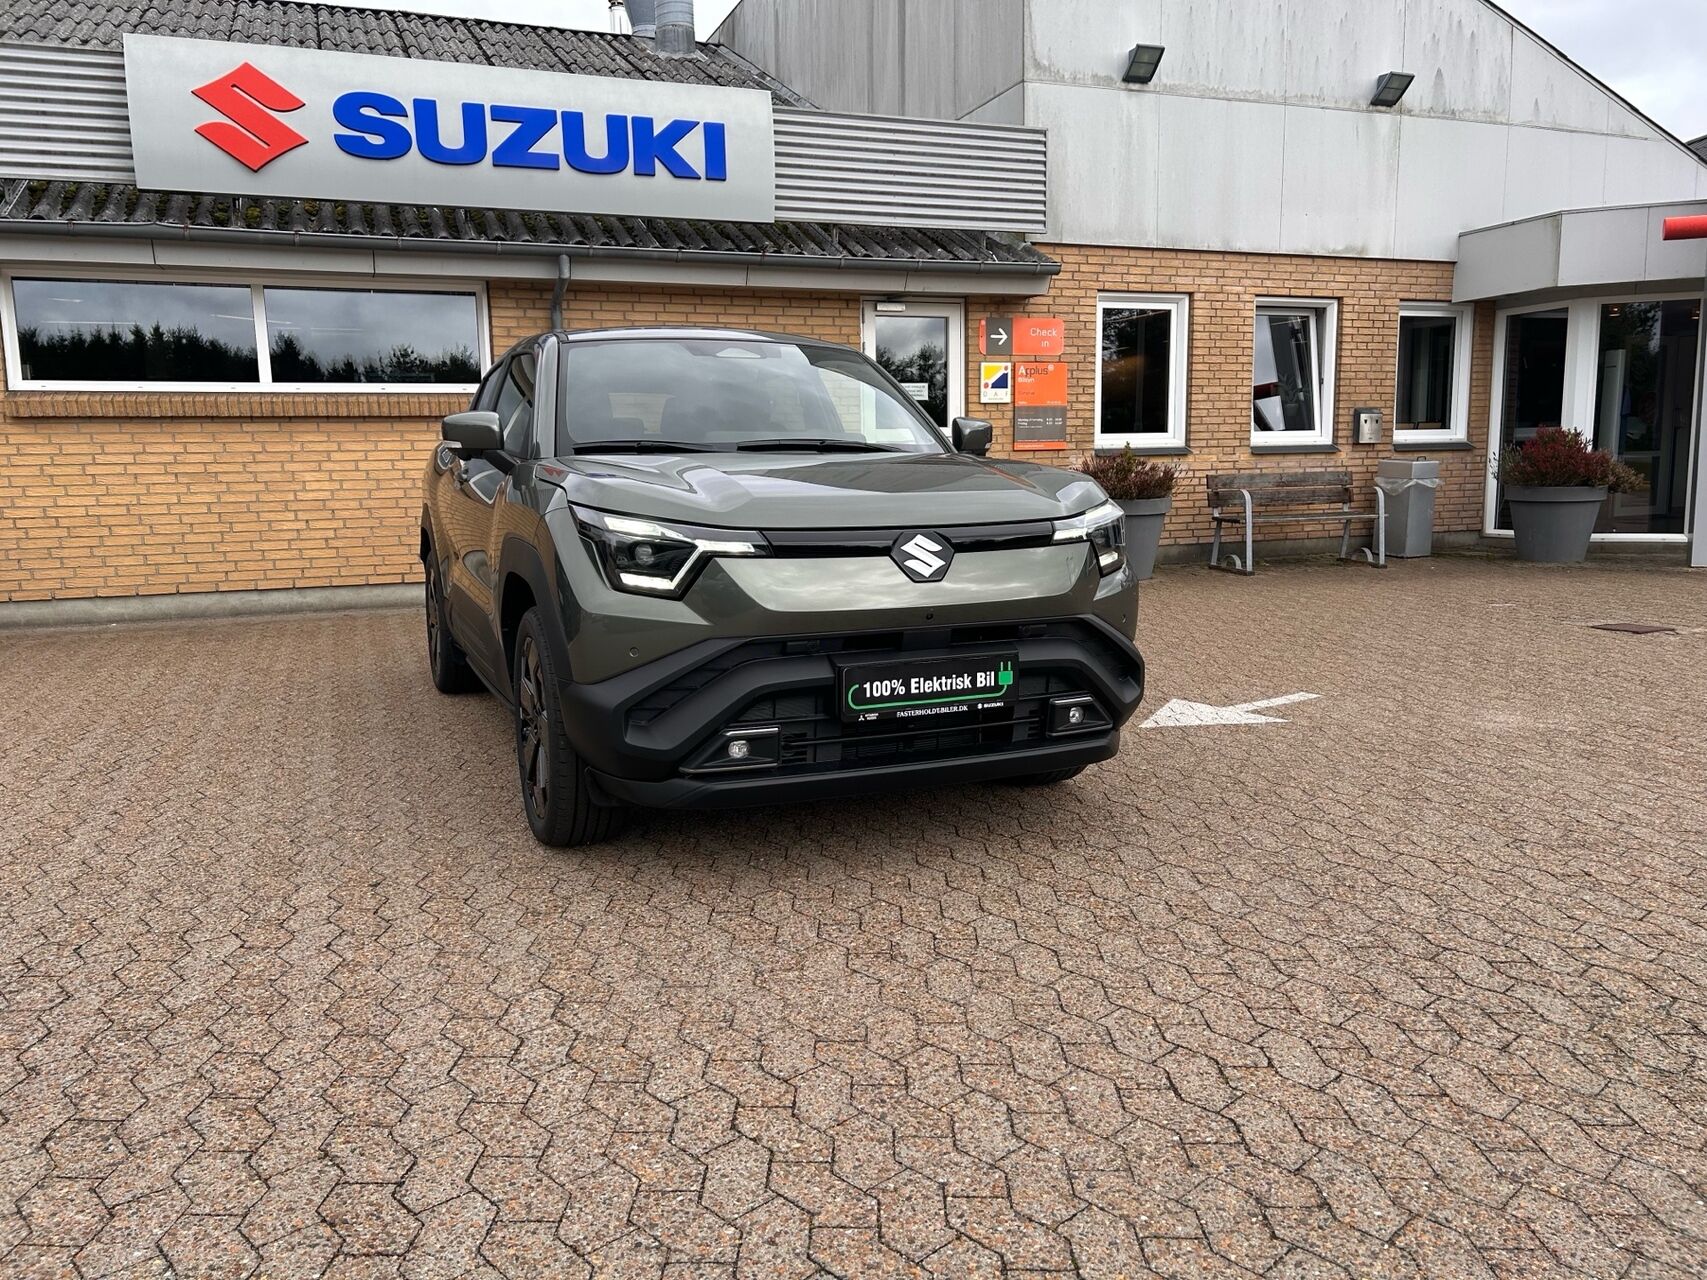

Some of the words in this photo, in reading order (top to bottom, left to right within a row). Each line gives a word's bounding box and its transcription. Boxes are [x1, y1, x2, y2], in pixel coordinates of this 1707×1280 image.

[333, 91, 727, 181] SUZUKI
[1030, 327, 1057, 337] Check
[863, 678, 906, 698] 100%
[910, 673, 972, 694] Elektrisk
[976, 671, 995, 687] Bil
